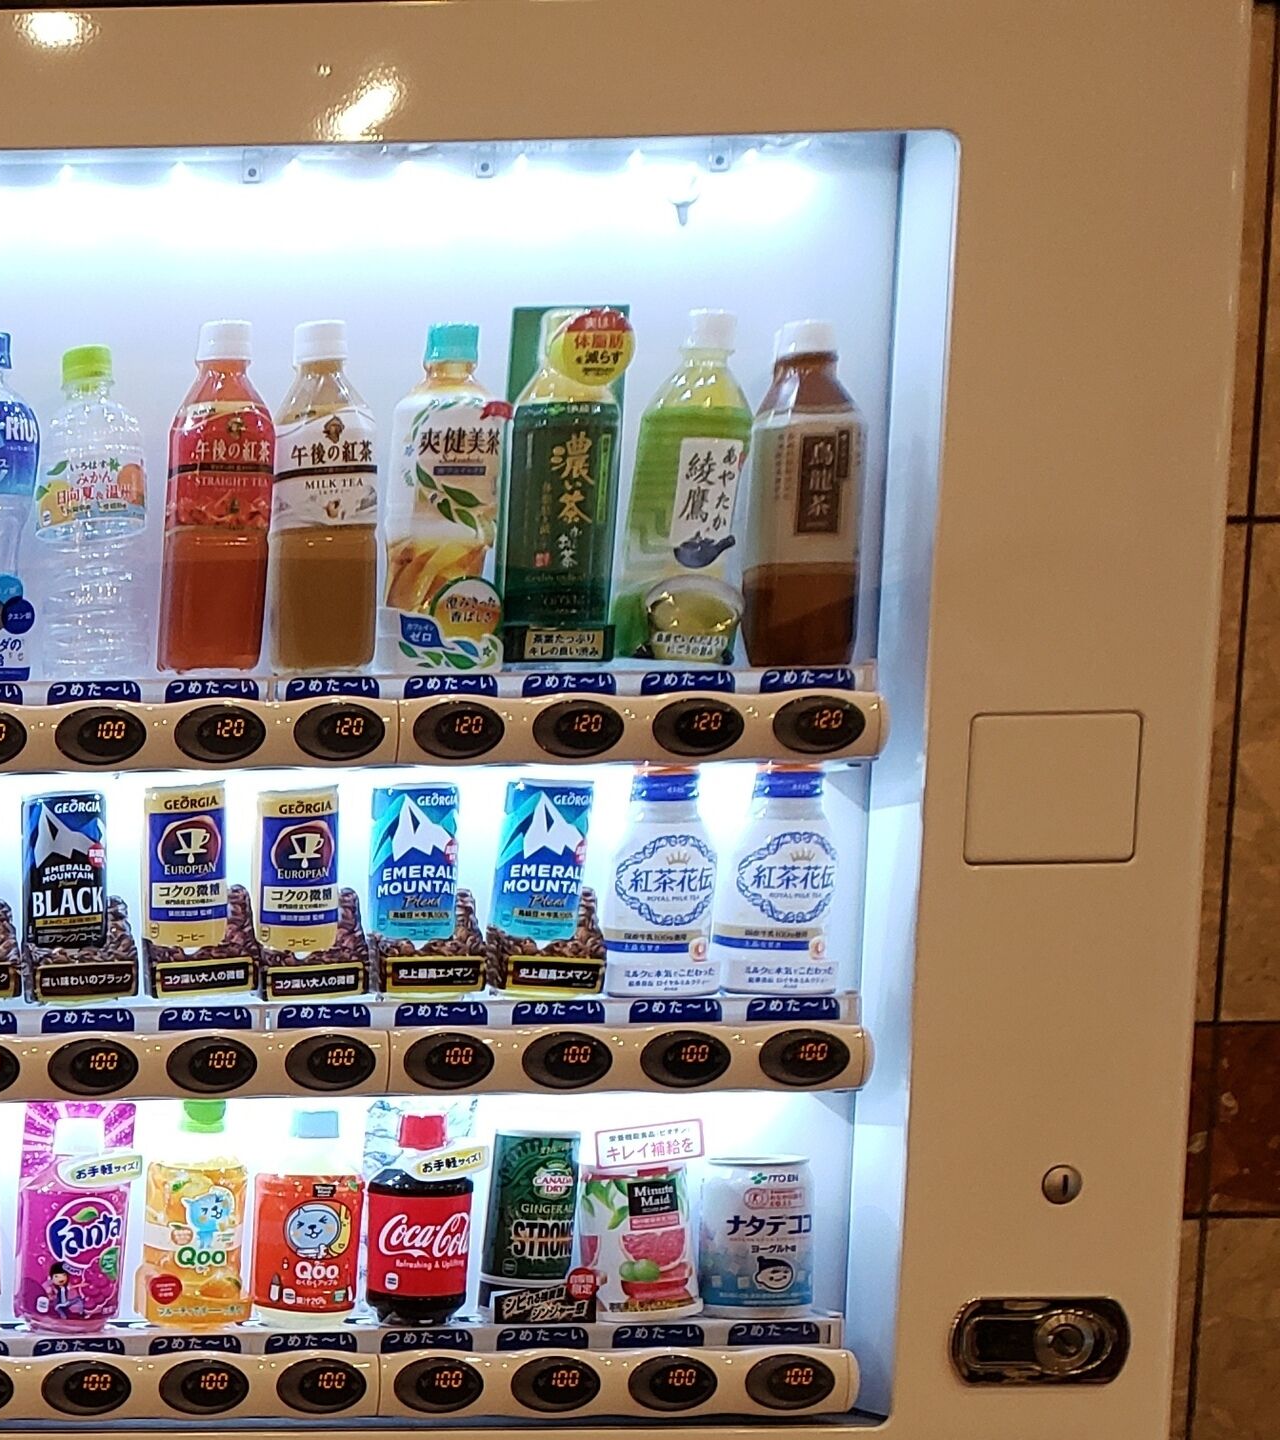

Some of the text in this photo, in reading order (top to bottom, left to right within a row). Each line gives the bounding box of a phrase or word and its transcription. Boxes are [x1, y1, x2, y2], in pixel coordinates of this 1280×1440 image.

[418, 427, 500, 454] 爽健美茶
[195, 440, 270, 462] 午後の紅茶
[291, 442, 372, 465] 午後の紅茶
[77, 472, 112, 484] みかん
[194, 476, 269, 488] STRAIGHT TEA
[305, 478, 363, 489] MILK TEA
[680, 453, 716, 523] 綾鷹
[712, 445, 739, 531] あやたか
[409, 632, 432, 643] ゼロ
[96, 721, 125, 739] 100
[216, 719, 244, 737] 120
[336, 718, 363, 735] 120
[573, 715, 602, 733] 120
[43, 872, 94, 883] MOUNTAIN
[45, 864, 93, 876] EMERALD
[164, 863, 217, 876] EUROPEAN
[752, 866, 835, 889] 紅茶花伝
[629, 868, 714, 893] 紅茶花伝
[32, 886, 103, 917] BLACK
[271, 887, 332, 903] コクの微糖
[176, 932, 206, 944] コーヒー
[89, 1052, 118, 1071] 100
[208, 1051, 236, 1069] 100
[445, 1046, 473, 1065] 100
[563, 1044, 591, 1064] 100
[607, 1139, 694, 1162] キレイ補給を
[75, 1162, 139, 1179] お手軽サイズ!
[634, 1185, 674, 1196] Minute
[641, 1196, 671, 1206] Maid
[726, 1214, 812, 1236] ナタデココ
[49, 1213, 122, 1259] Fanta
[177, 1245, 226, 1266] Qoo
[295, 1261, 339, 1281] Qoo
[83, 1373, 112, 1391] 100
[434, 1370, 462, 1389] 100
[551, 1371, 579, 1389] 100
[784, 1368, 813, 1386] 100
